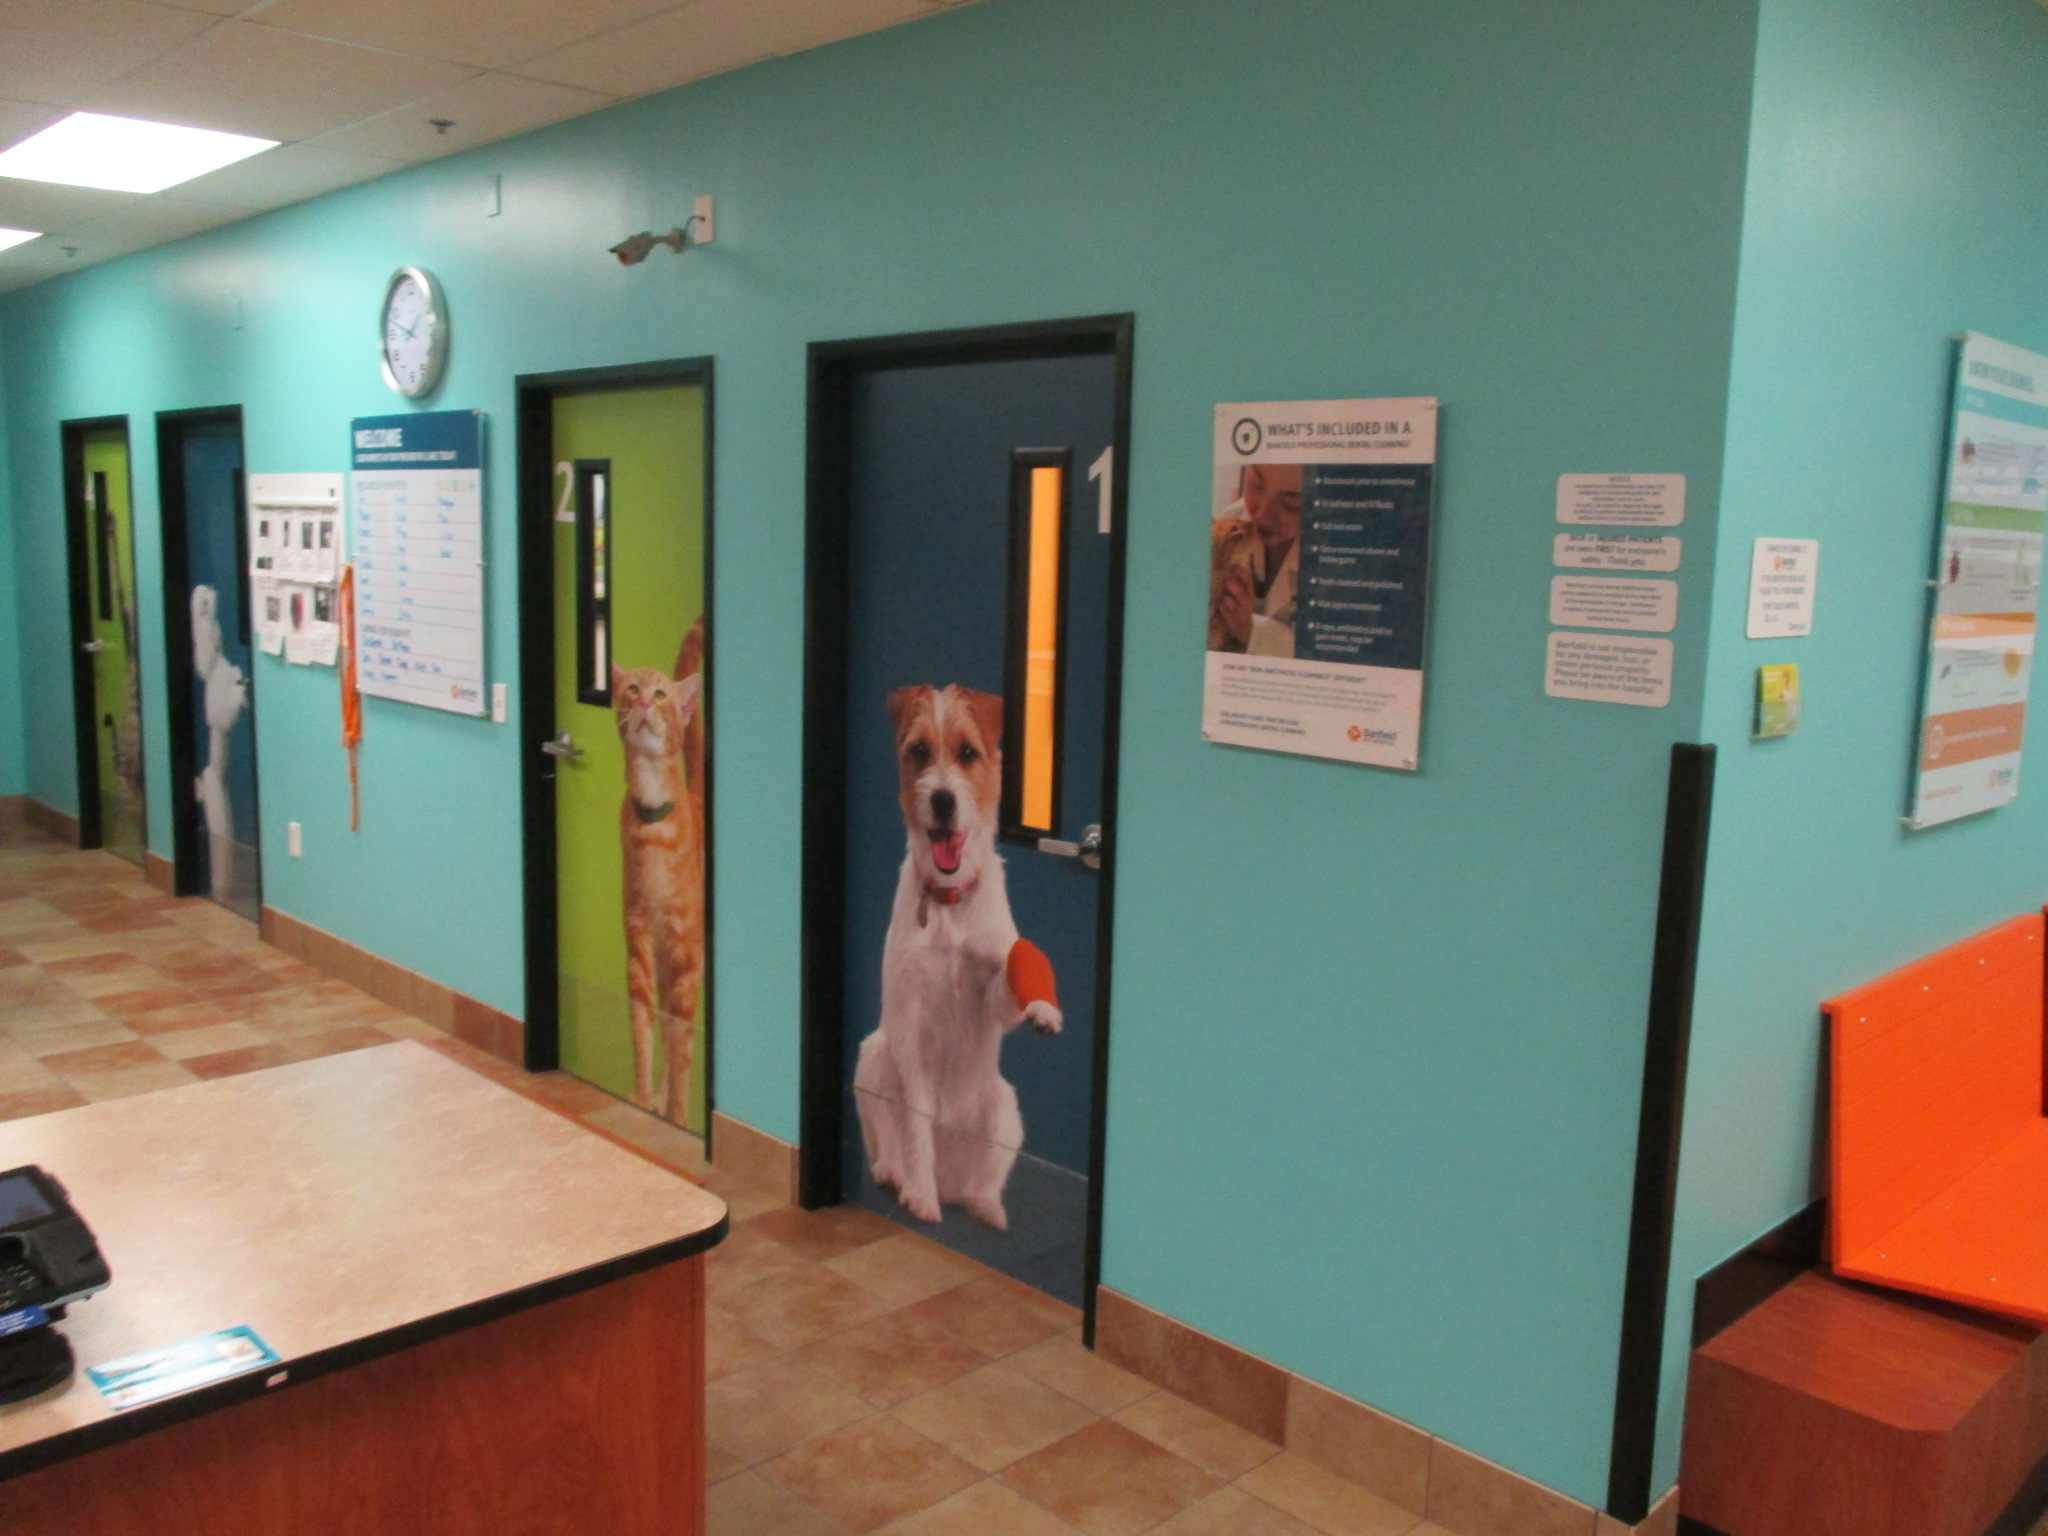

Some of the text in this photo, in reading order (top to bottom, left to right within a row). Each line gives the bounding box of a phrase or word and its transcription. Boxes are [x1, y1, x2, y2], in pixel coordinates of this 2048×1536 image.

[1267, 421, 1411, 436] WHAT'S INCLUDED IN A
[555, 461, 576, 522] 2
[1088, 446, 1113, 534] 1
